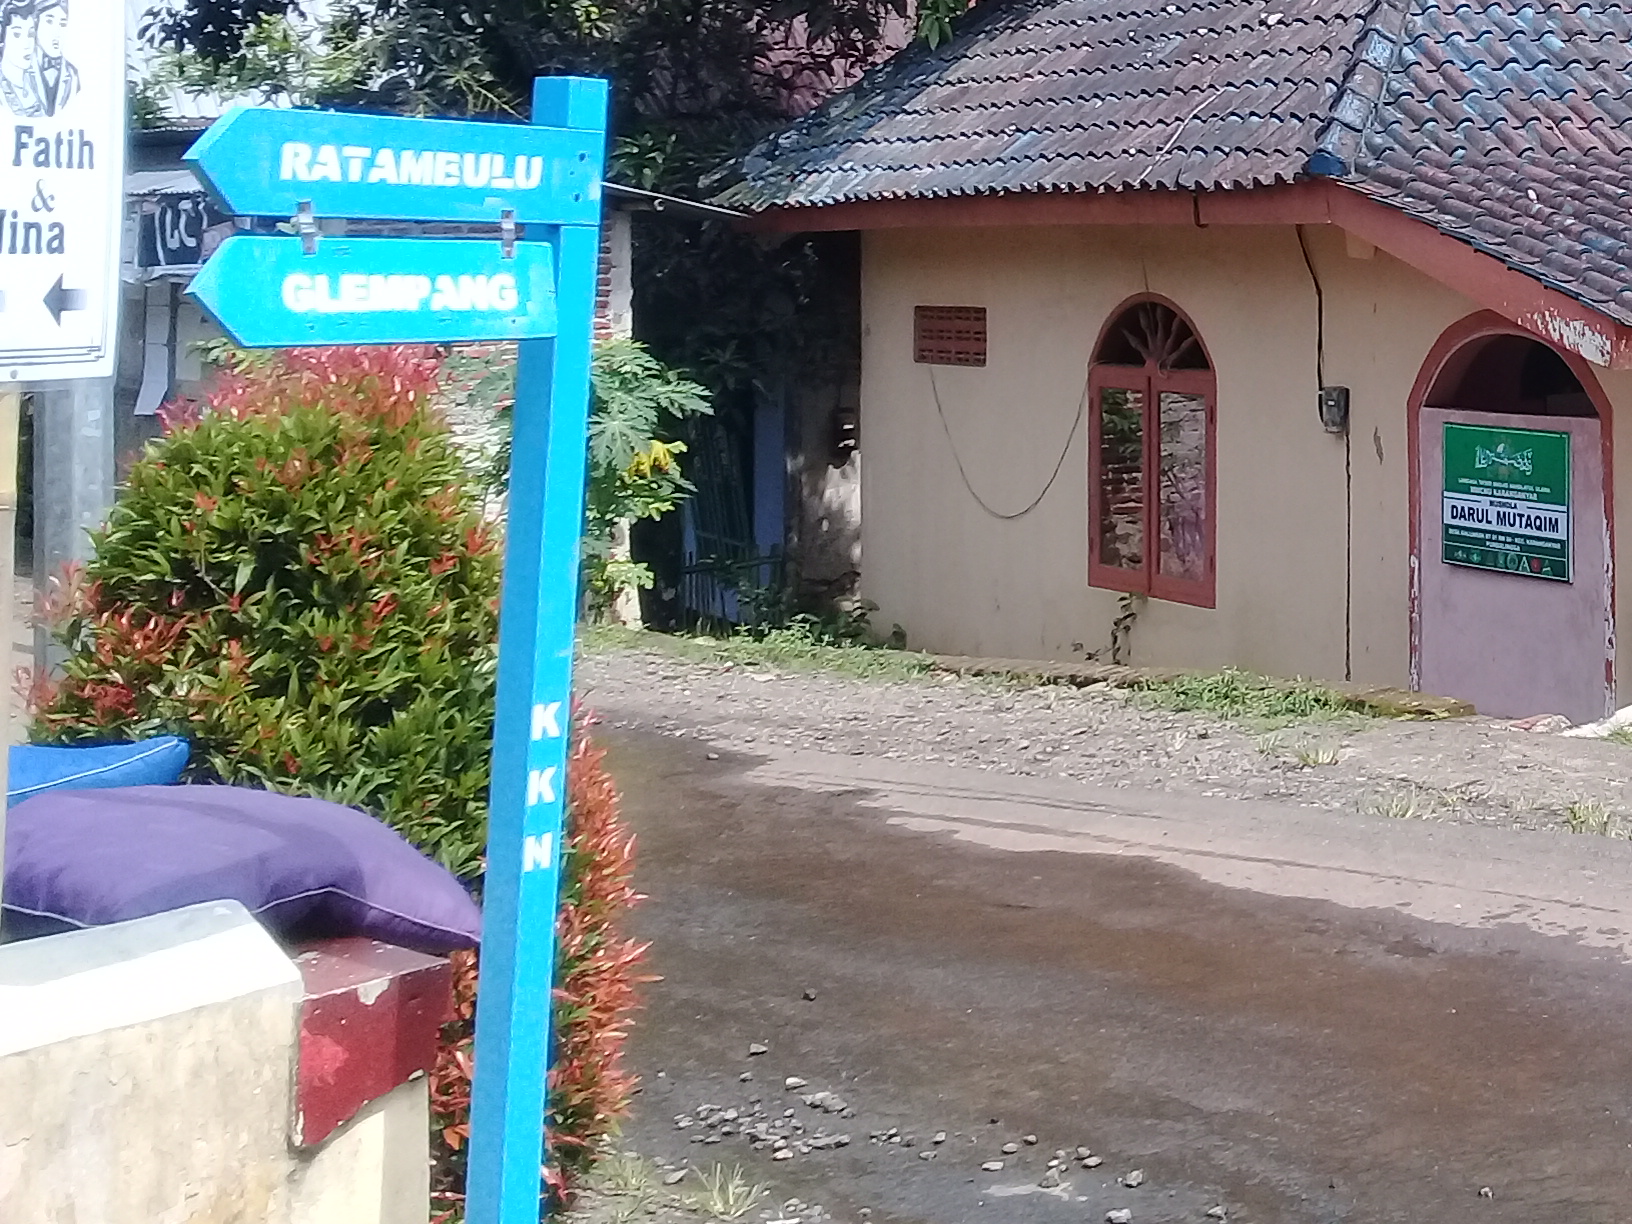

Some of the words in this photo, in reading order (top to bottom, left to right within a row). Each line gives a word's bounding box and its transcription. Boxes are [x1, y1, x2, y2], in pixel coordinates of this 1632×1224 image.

[12, 125, 94, 169] Fatih
[280, 141, 544, 190] RATAMBULU
[31, 178, 55, 213] &
[0, 209, 65, 254] ina
[281, 272, 519, 313] GLEMPANG
[1451, 504, 1493, 525] DARUL
[1496, 510, 1559, 534] MUTAQIM
